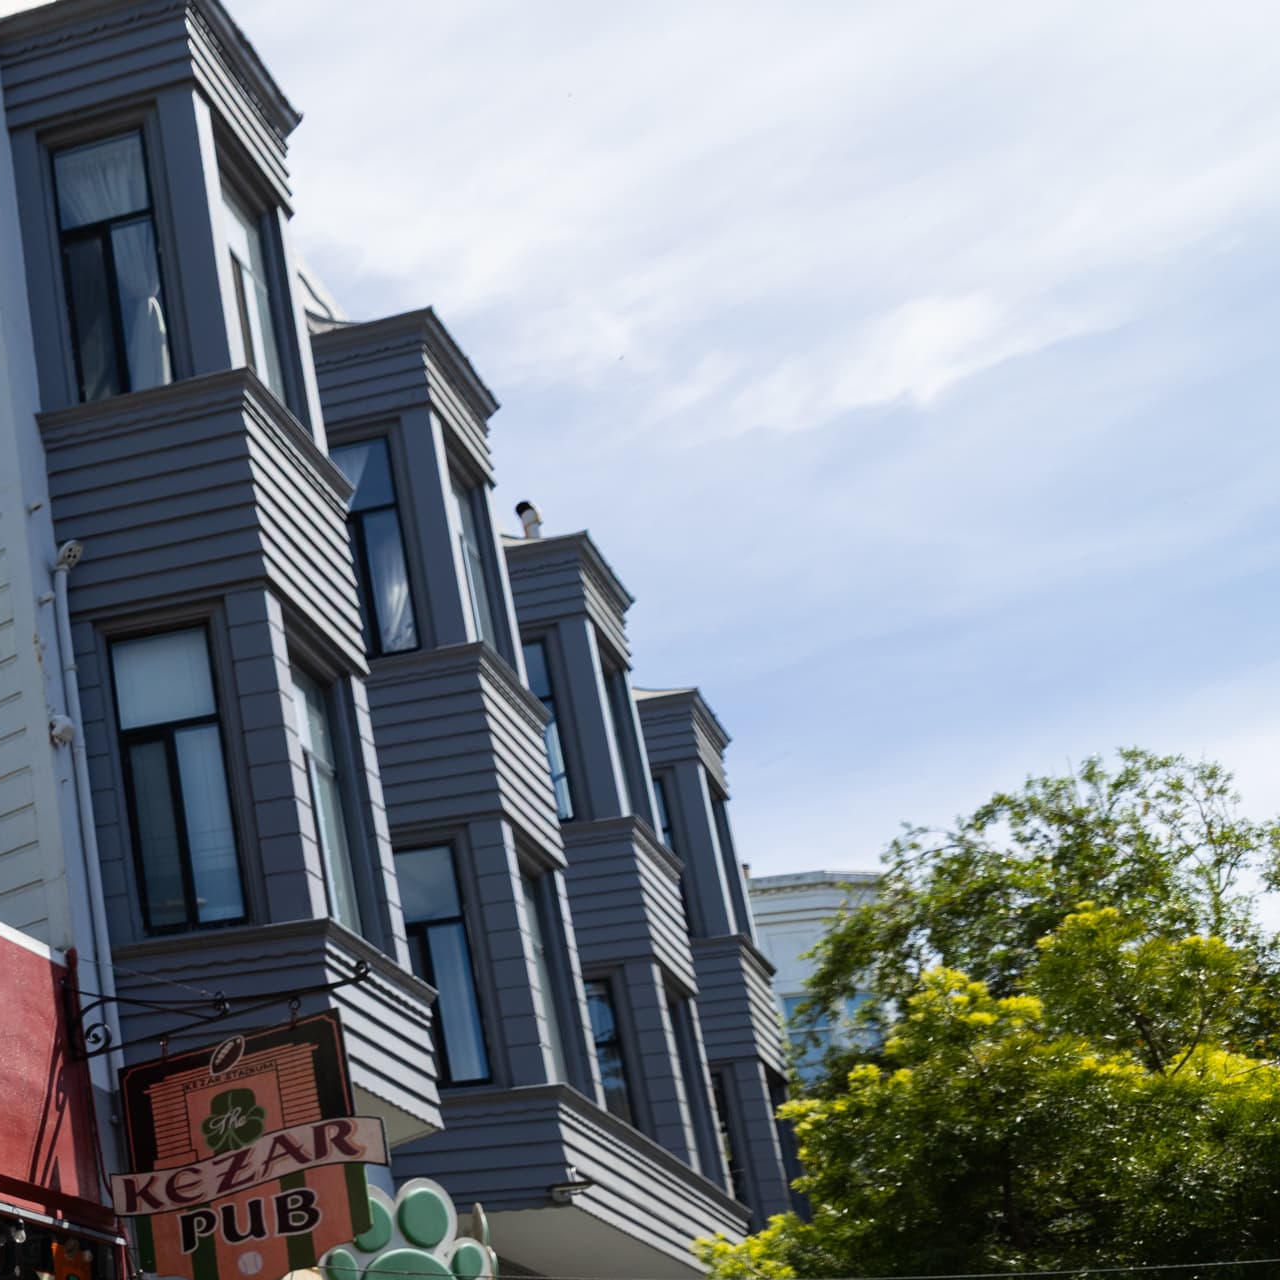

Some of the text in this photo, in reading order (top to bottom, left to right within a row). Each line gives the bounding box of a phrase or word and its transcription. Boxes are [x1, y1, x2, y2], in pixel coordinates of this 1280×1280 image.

[208, 1105, 247, 1136] The
[123, 1119, 364, 1214] KEZAR
[179, 1187, 321, 1256] PUB
